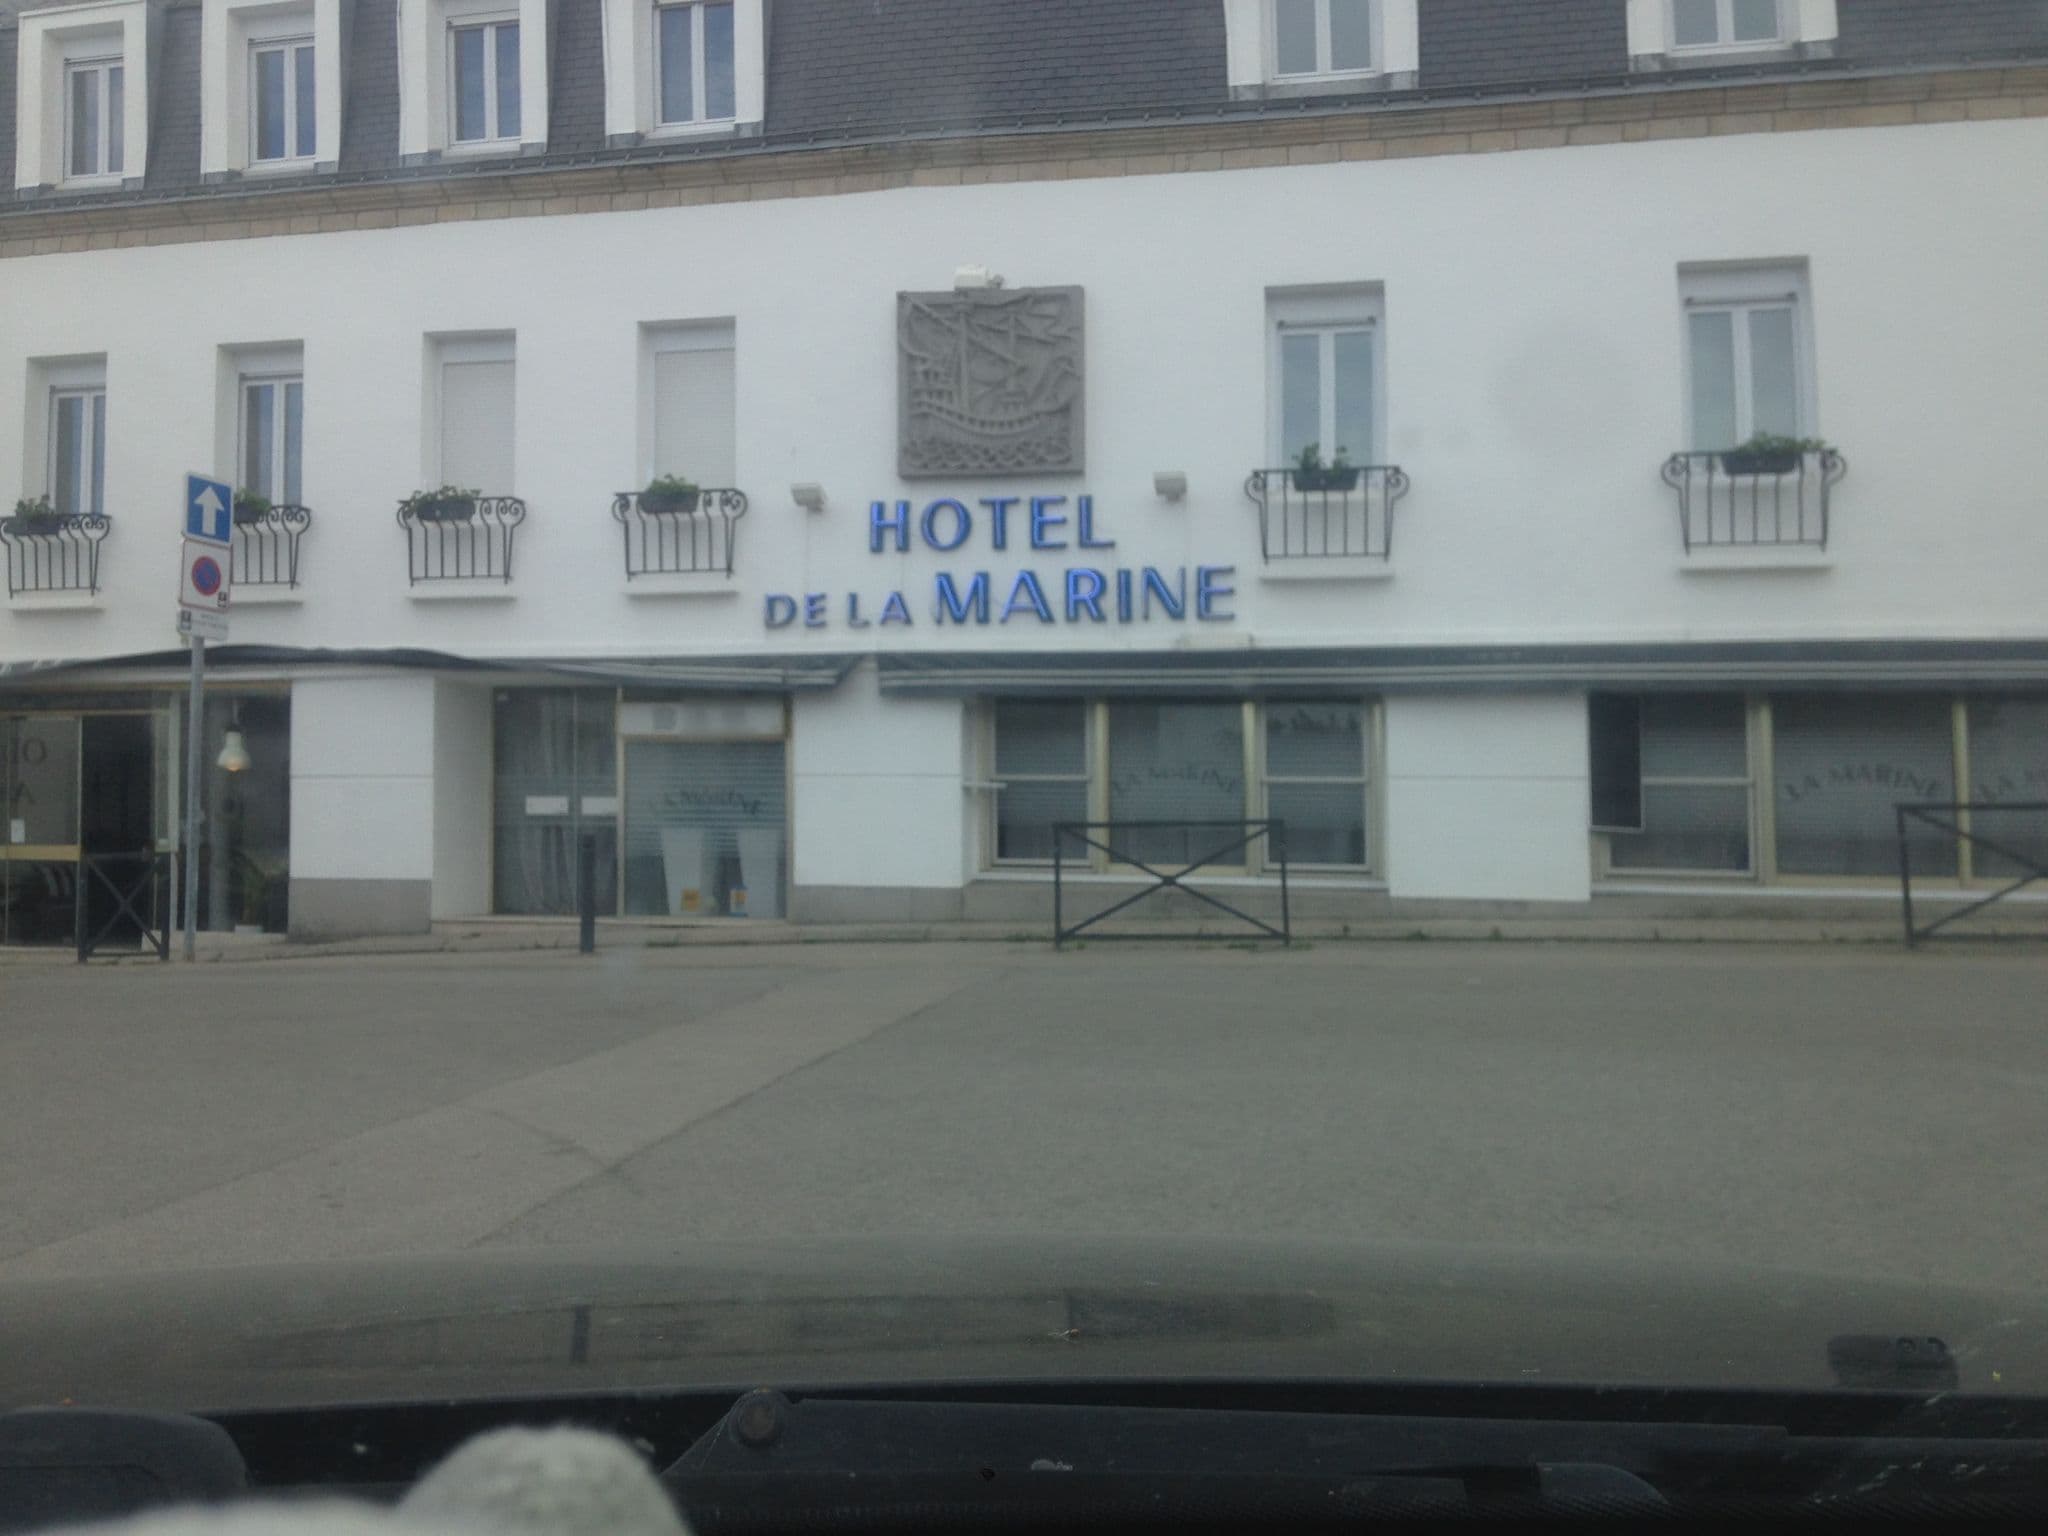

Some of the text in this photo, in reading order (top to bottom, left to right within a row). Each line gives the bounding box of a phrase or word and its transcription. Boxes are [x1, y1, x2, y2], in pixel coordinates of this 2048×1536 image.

[869, 495, 1116, 553] HOTEL
[764, 565, 1237, 628] DE LA MARINE
